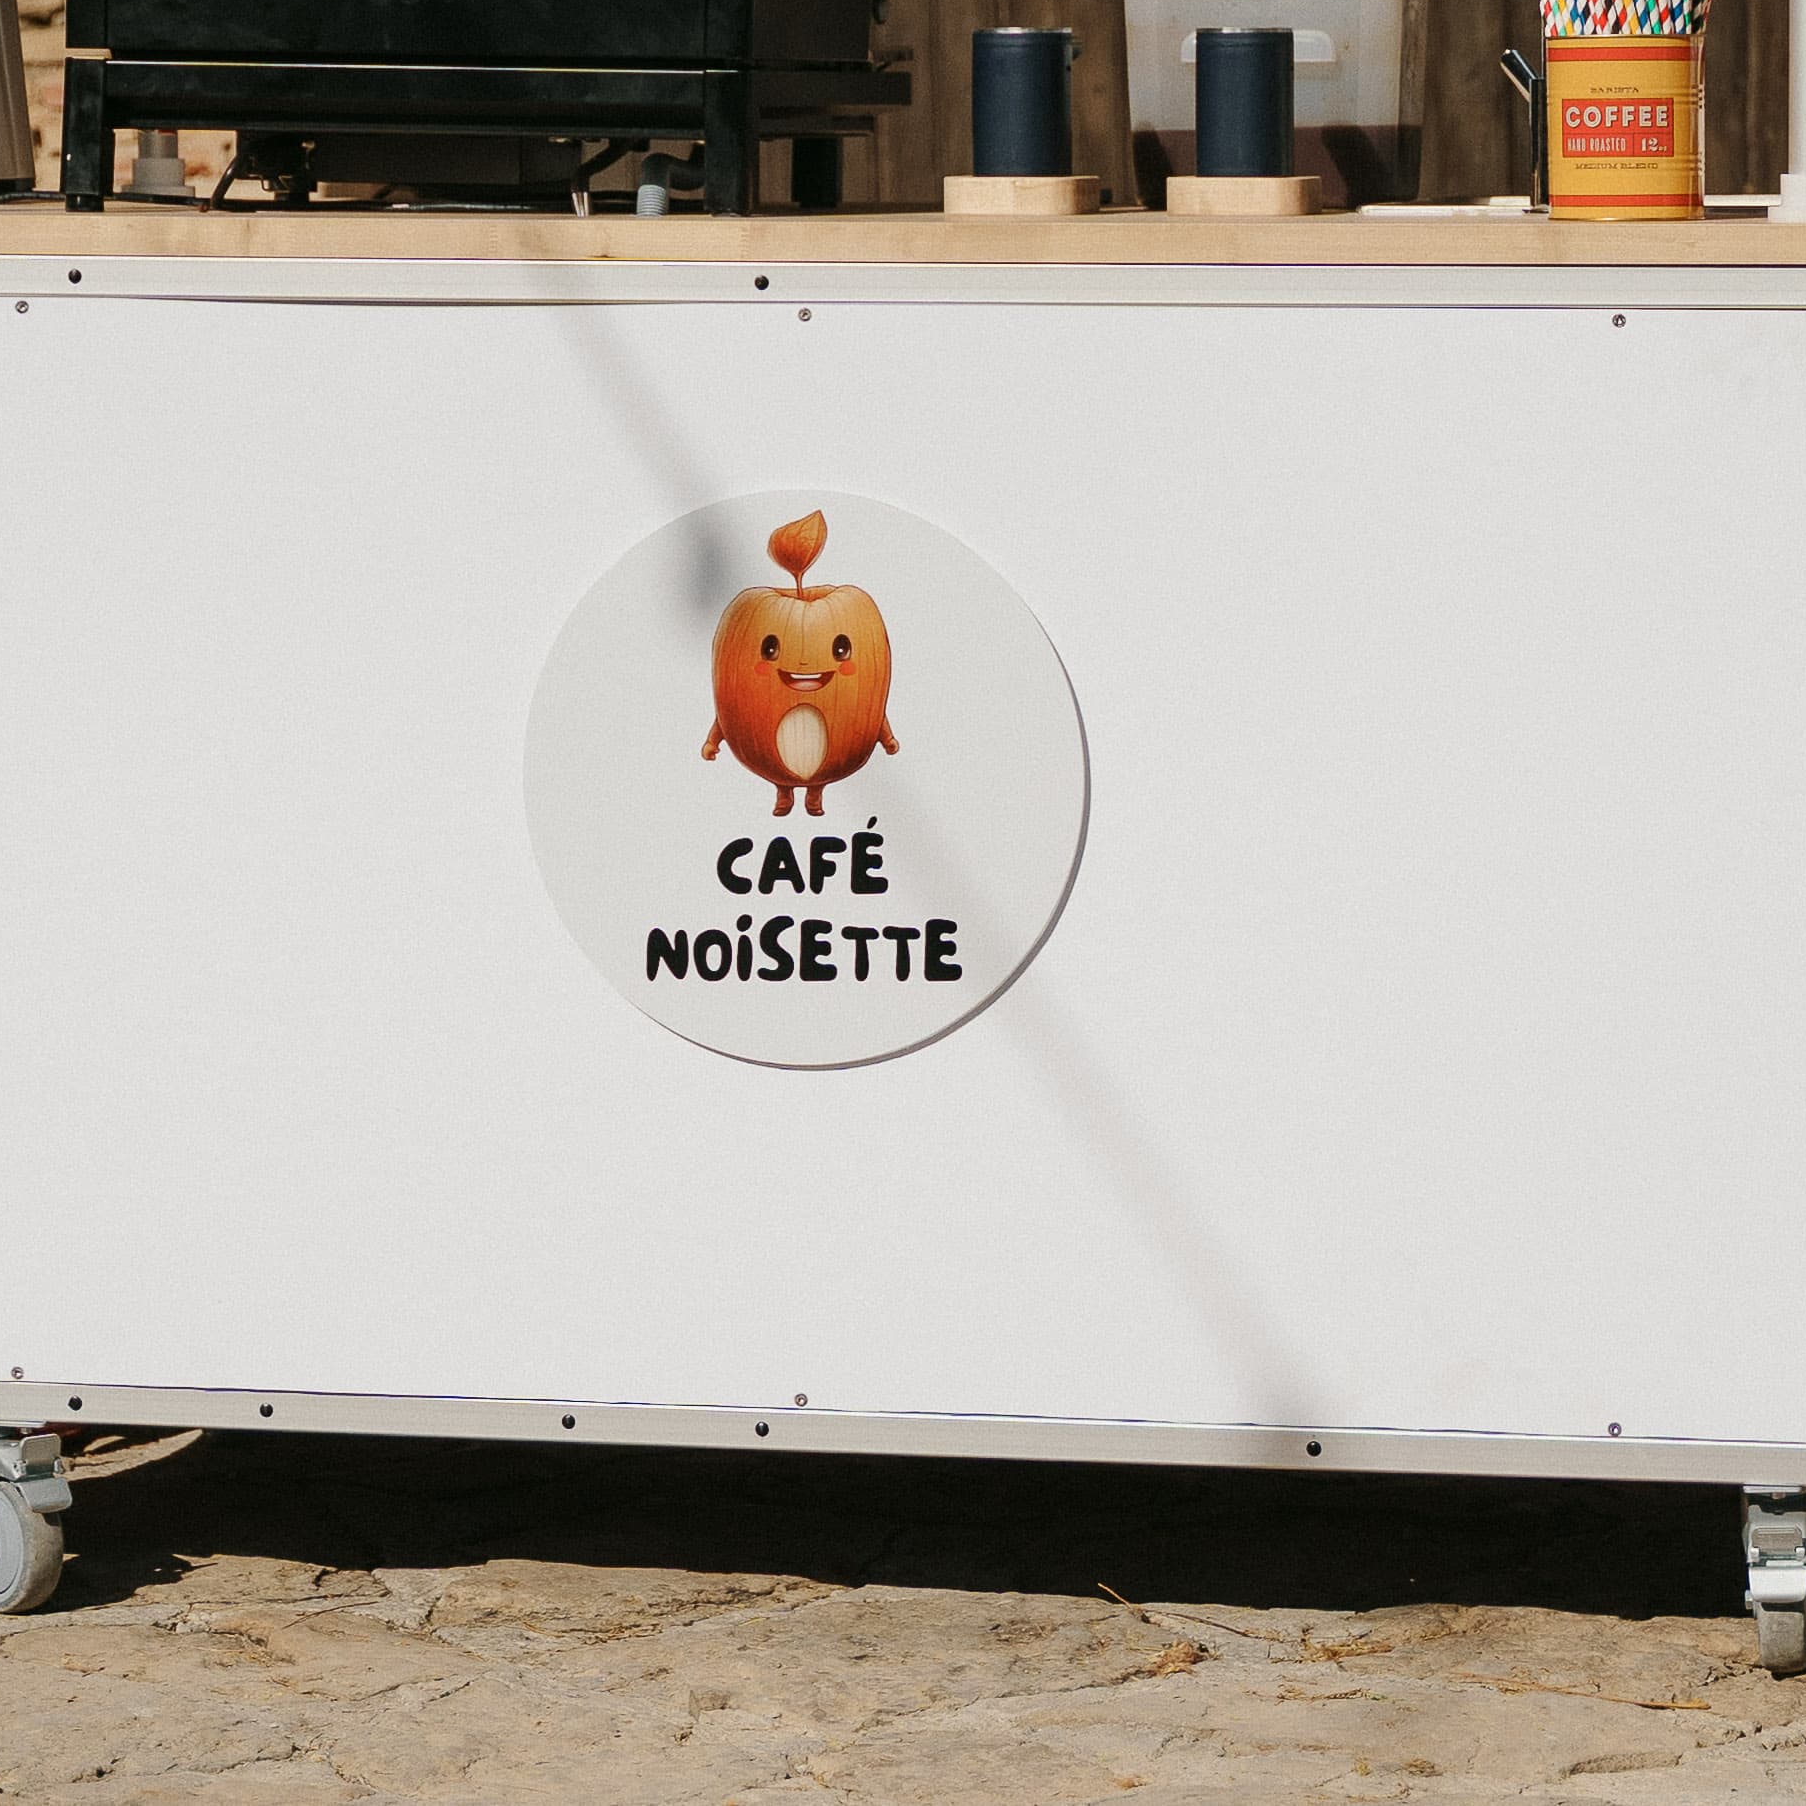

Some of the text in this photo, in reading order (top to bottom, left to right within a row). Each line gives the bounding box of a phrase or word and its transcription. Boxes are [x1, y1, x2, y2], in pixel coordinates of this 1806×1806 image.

[1565, 105, 1669, 128] COFFEE
[1589, 137, 1627, 152] ROASTED
[716, 816, 889, 895] CAFÉ
